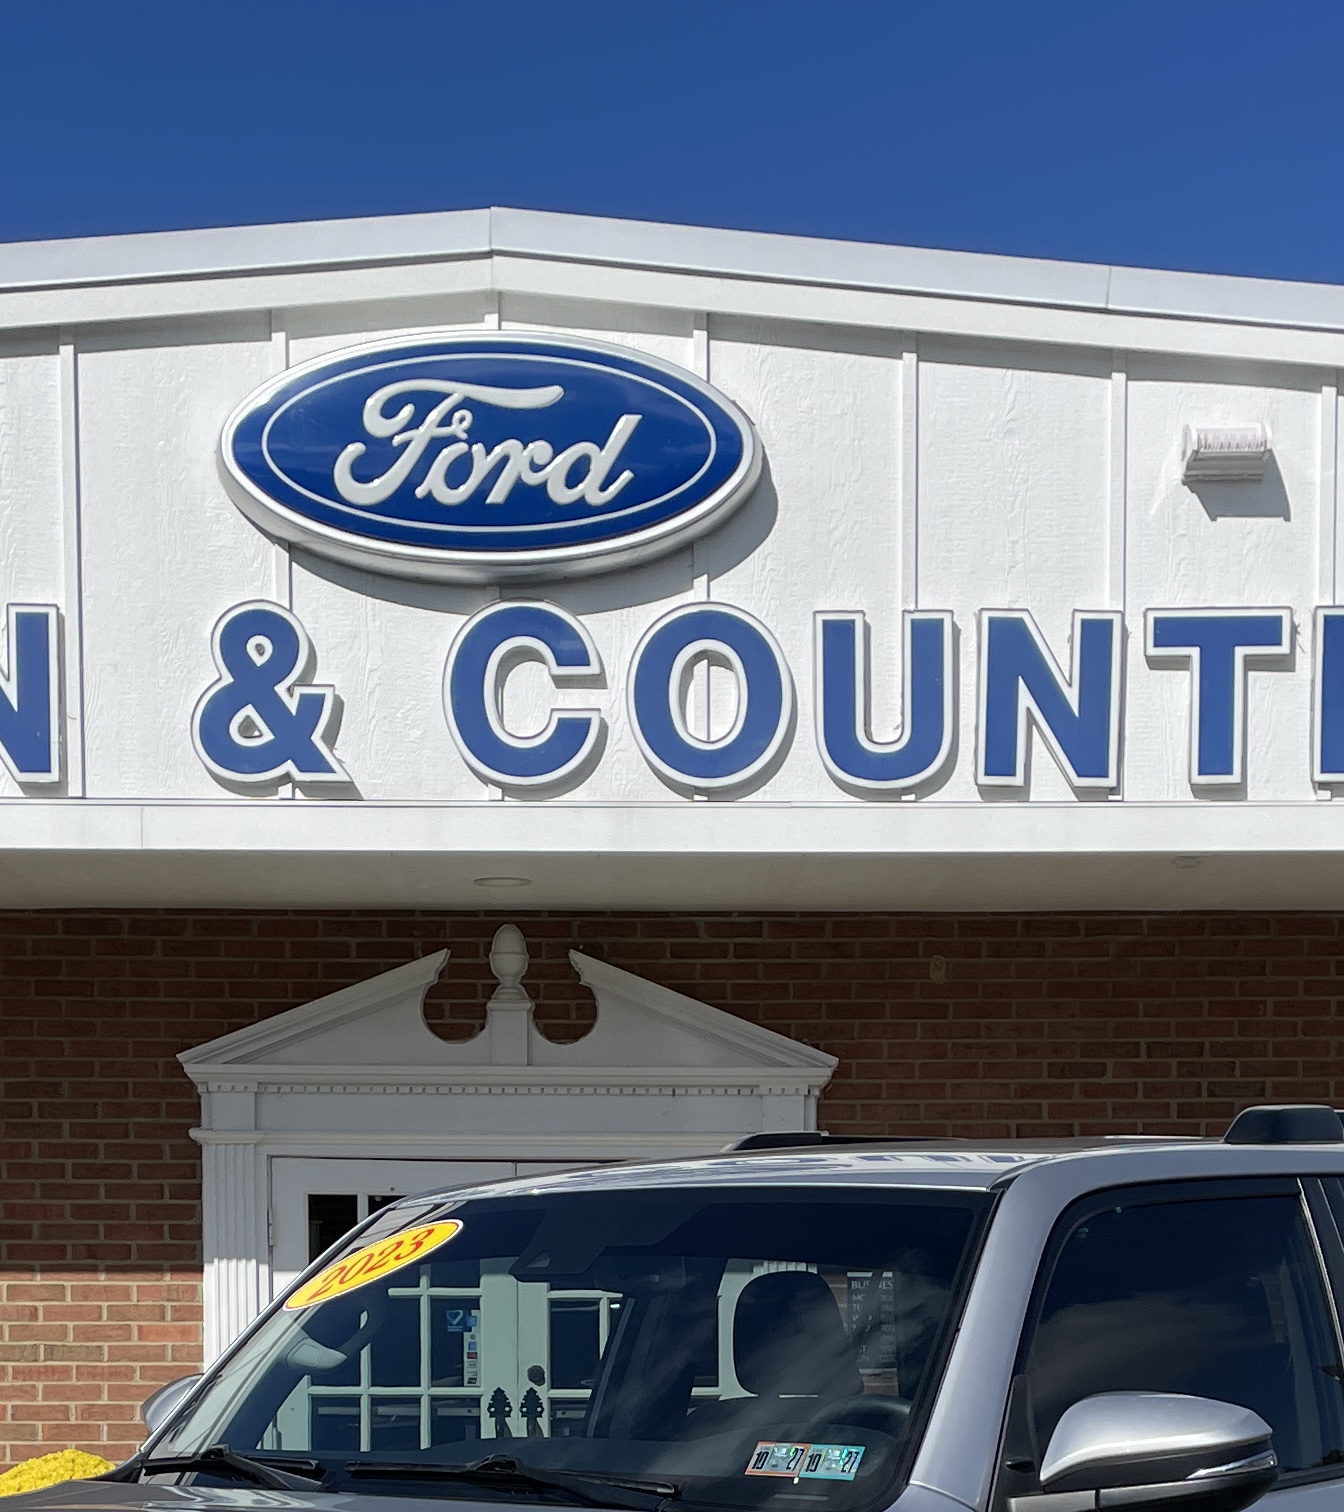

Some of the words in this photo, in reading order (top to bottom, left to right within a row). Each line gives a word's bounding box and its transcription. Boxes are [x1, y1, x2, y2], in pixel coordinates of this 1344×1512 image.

[333, 378, 642, 506] Ford
[191, 599, 351, 783] &
[307, 1228, 435, 1301] 2023
